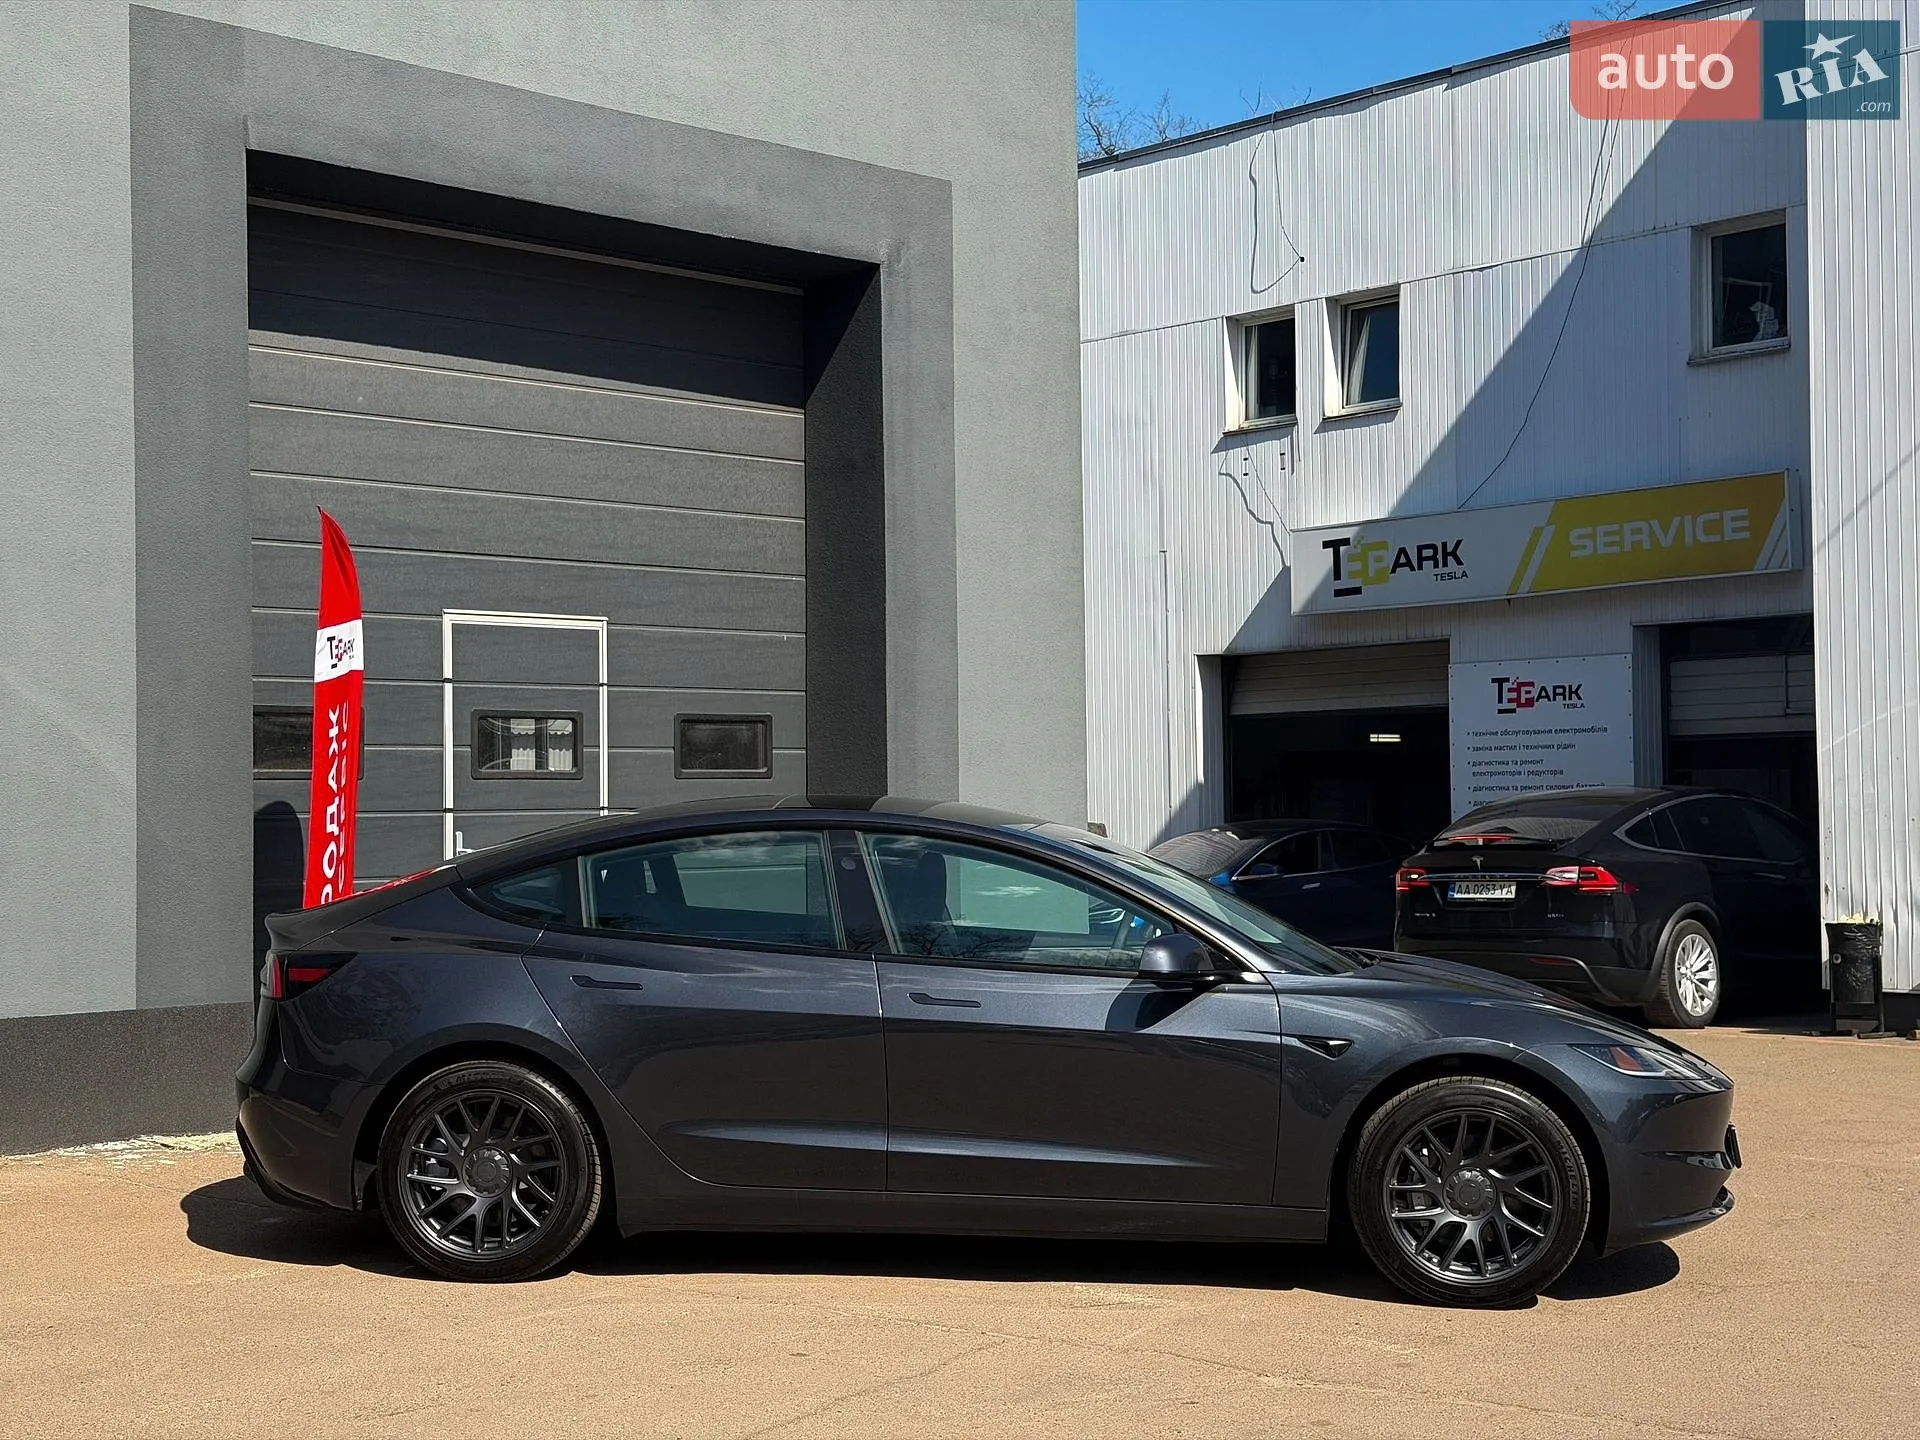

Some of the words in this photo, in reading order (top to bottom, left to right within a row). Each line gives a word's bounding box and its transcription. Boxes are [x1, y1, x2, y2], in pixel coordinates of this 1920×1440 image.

[1569, 508, 1750, 559] SERVICE
[1433, 570, 1469, 582] TESLA
[1500, 728, 1553, 737] обслуговування
[1554, 726, 1608, 736] електромобілів
[1472, 760, 1510, 768] діагностика
[1519, 758, 1544, 767] ремонт
[1472, 769, 1522, 778] електромоторів
[1527, 768, 1564, 777] редукторів
[1472, 784, 1510, 792] діагностика
[1519, 783, 1545, 792] ремонт
